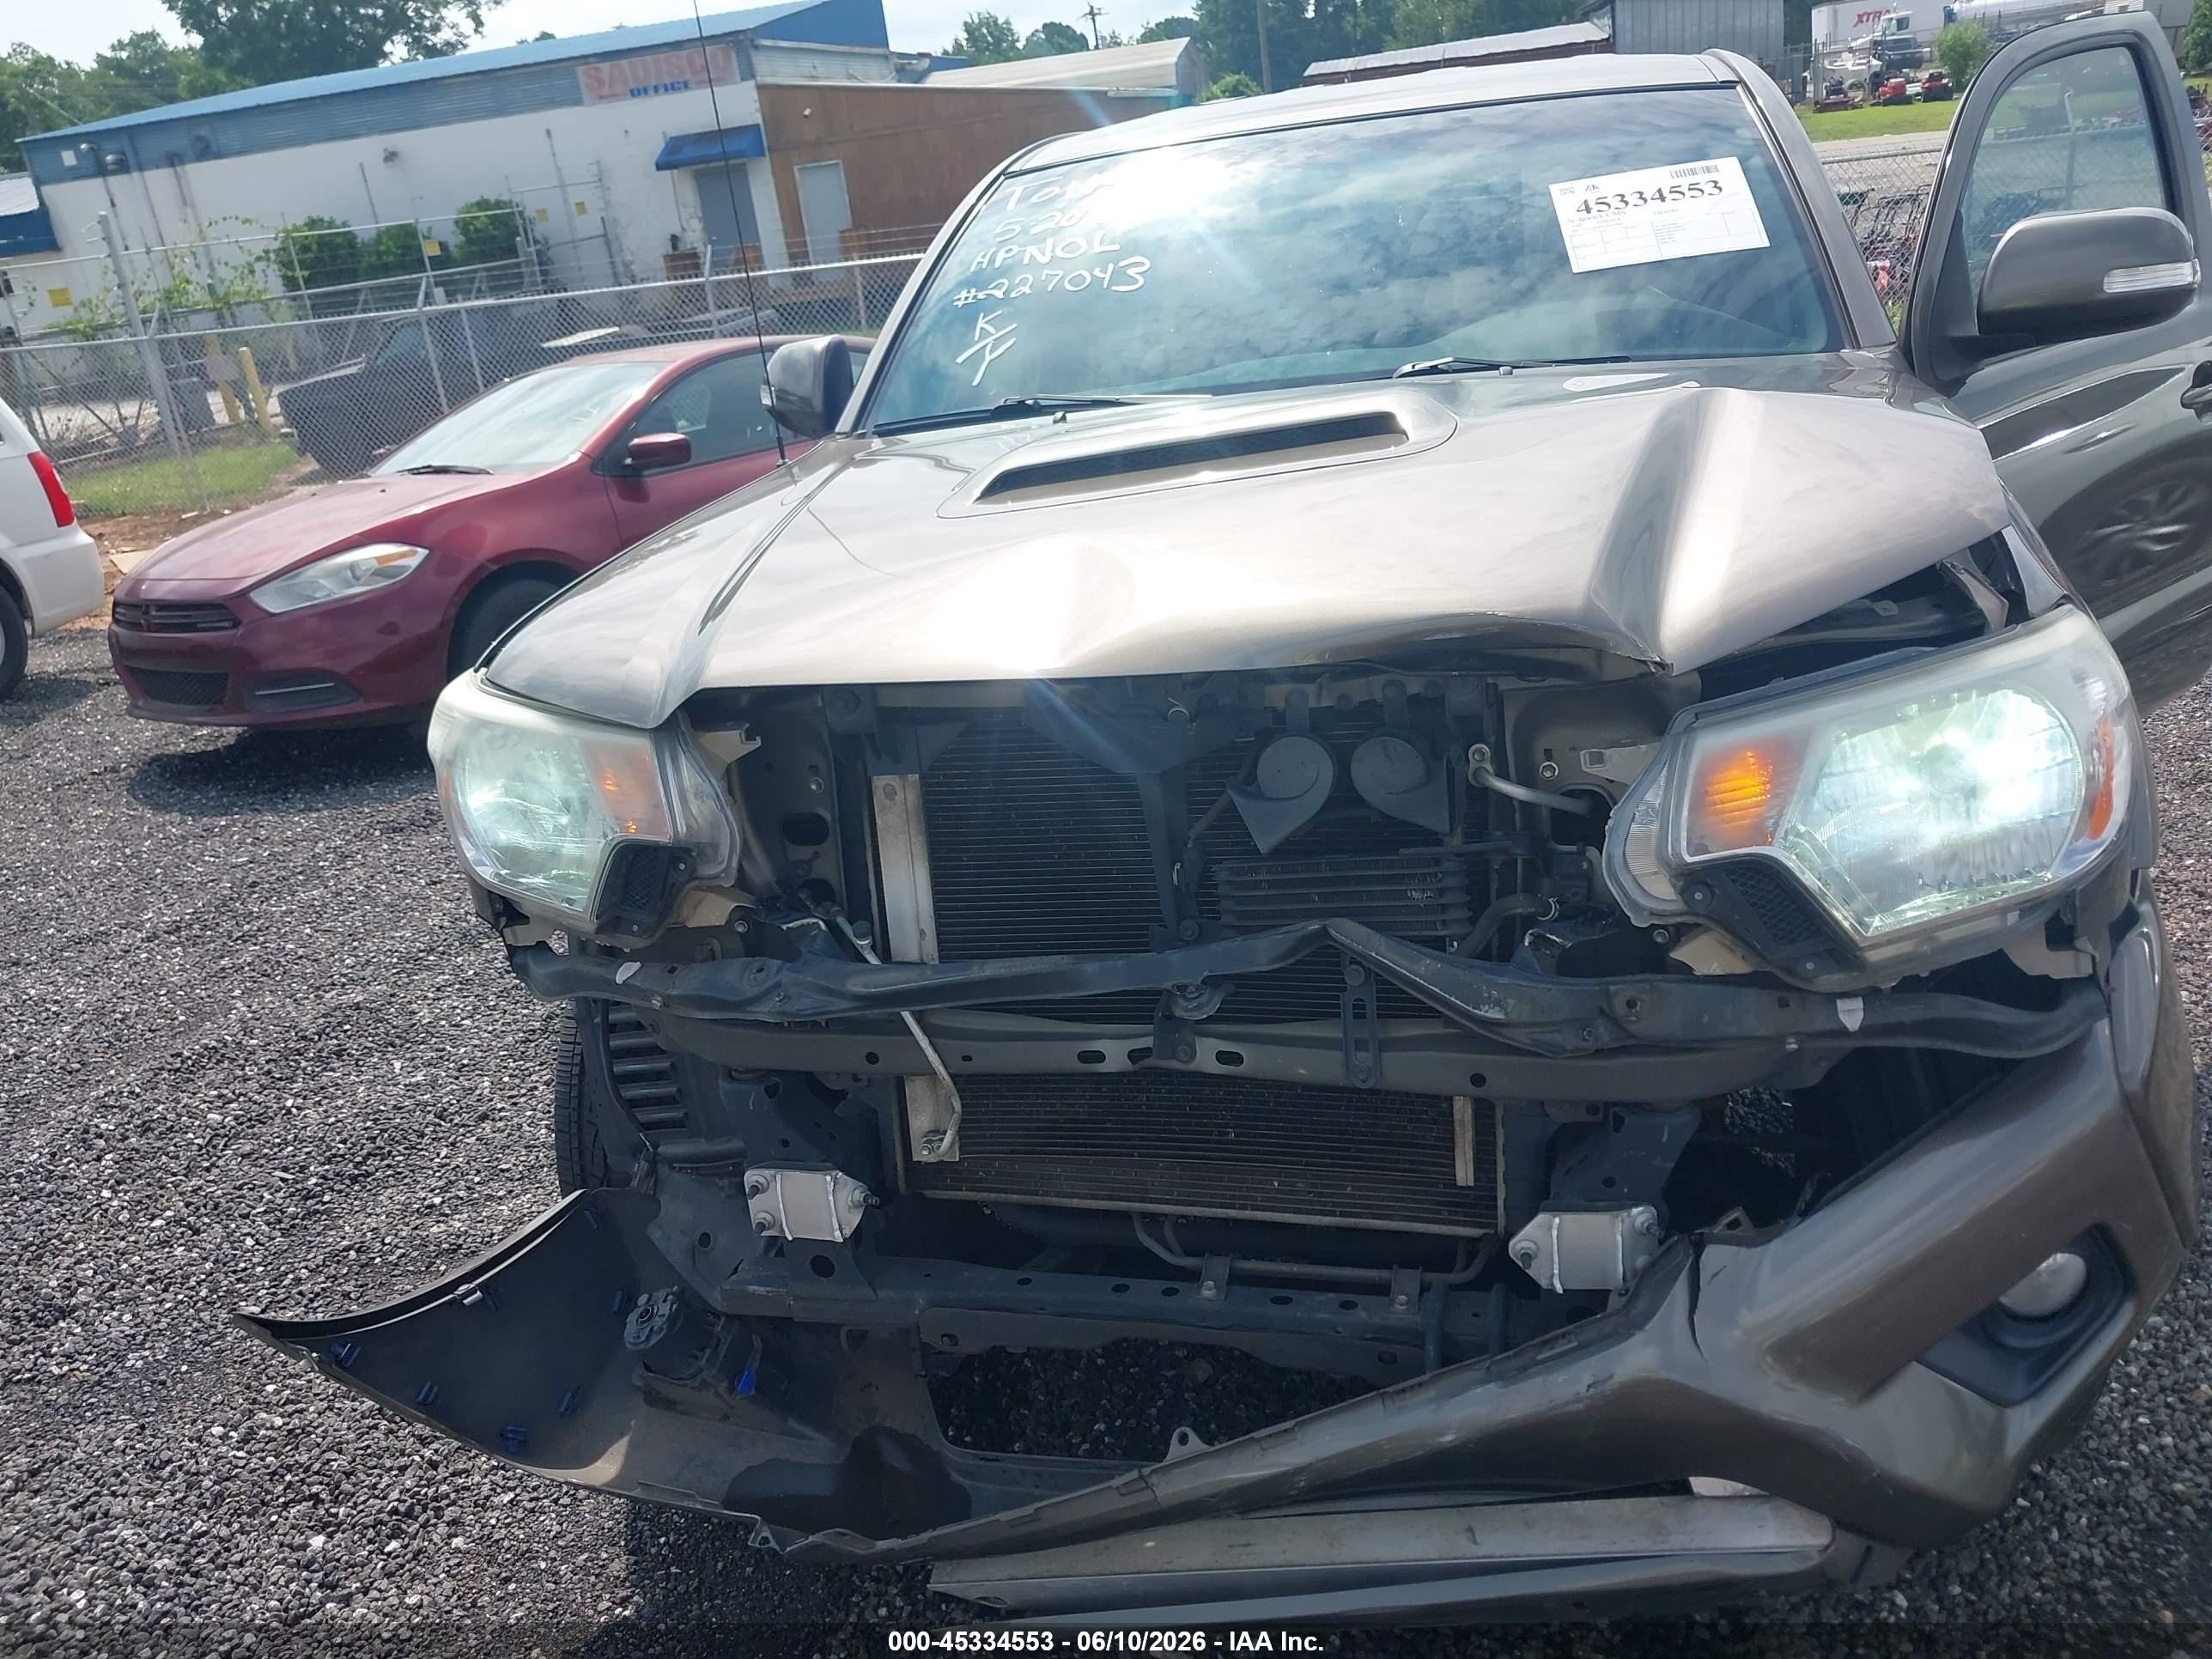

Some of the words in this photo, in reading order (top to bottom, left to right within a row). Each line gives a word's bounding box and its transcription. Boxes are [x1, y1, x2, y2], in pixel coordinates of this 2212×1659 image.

[629, 80, 693, 98] OFFICE
[1577, 179, 1723, 215] 45334553
[952, 256, 1152, 308] #227043
